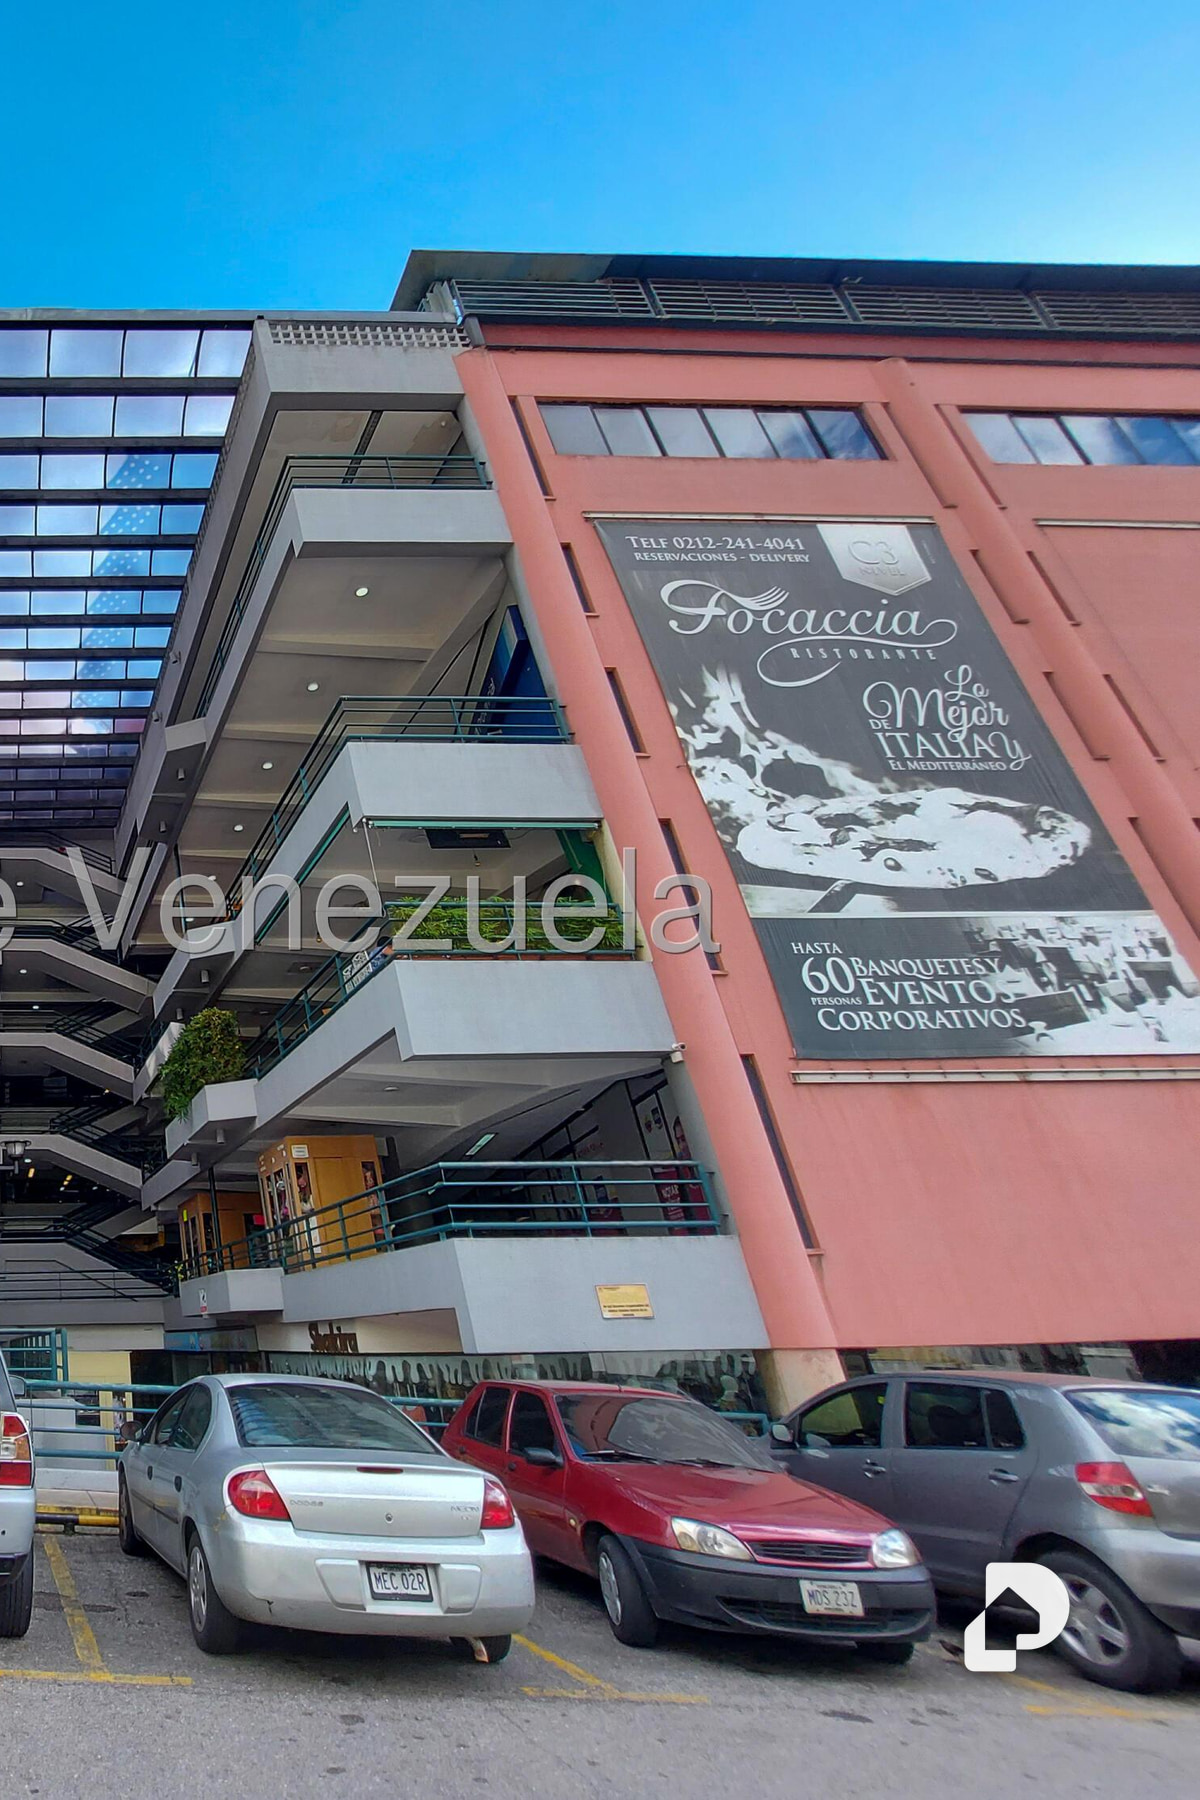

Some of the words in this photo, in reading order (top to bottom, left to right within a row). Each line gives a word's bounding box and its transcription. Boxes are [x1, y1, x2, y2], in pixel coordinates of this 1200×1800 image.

[625, 536, 668, 549] TELF
[673, 536, 805, 550] 0212-241-4041
[634, 552, 738, 562] RESERVACIONES
[749, 553, 811, 563] DELIVERY
[660, 579, 957, 638] Focaccia
[790, 648, 937, 660] RISTORANTE
[944, 664, 989, 702] Lo
[863, 681, 1009, 742] Mejor
[869, 719, 892, 730] DE
[874, 732, 1002, 759] ITALIA
[888, 760, 906, 771] EL
[907, 759, 1007, 771] MEDITERRÁNEO
[790, 942, 842, 954] HASTA
[801, 957, 856, 995] 60
[850, 957, 984, 979] BANQUETES
[857, 978, 1017, 1005] EVENTOS
[811, 997, 862, 1006] PERSONAS
[817, 1008, 1027, 1031] CORPORATIVOS
[373, 1572, 398, 1590] MEC
[401, 1573, 426, 1590] 02R
[806, 1589, 831, 1606] MDS
